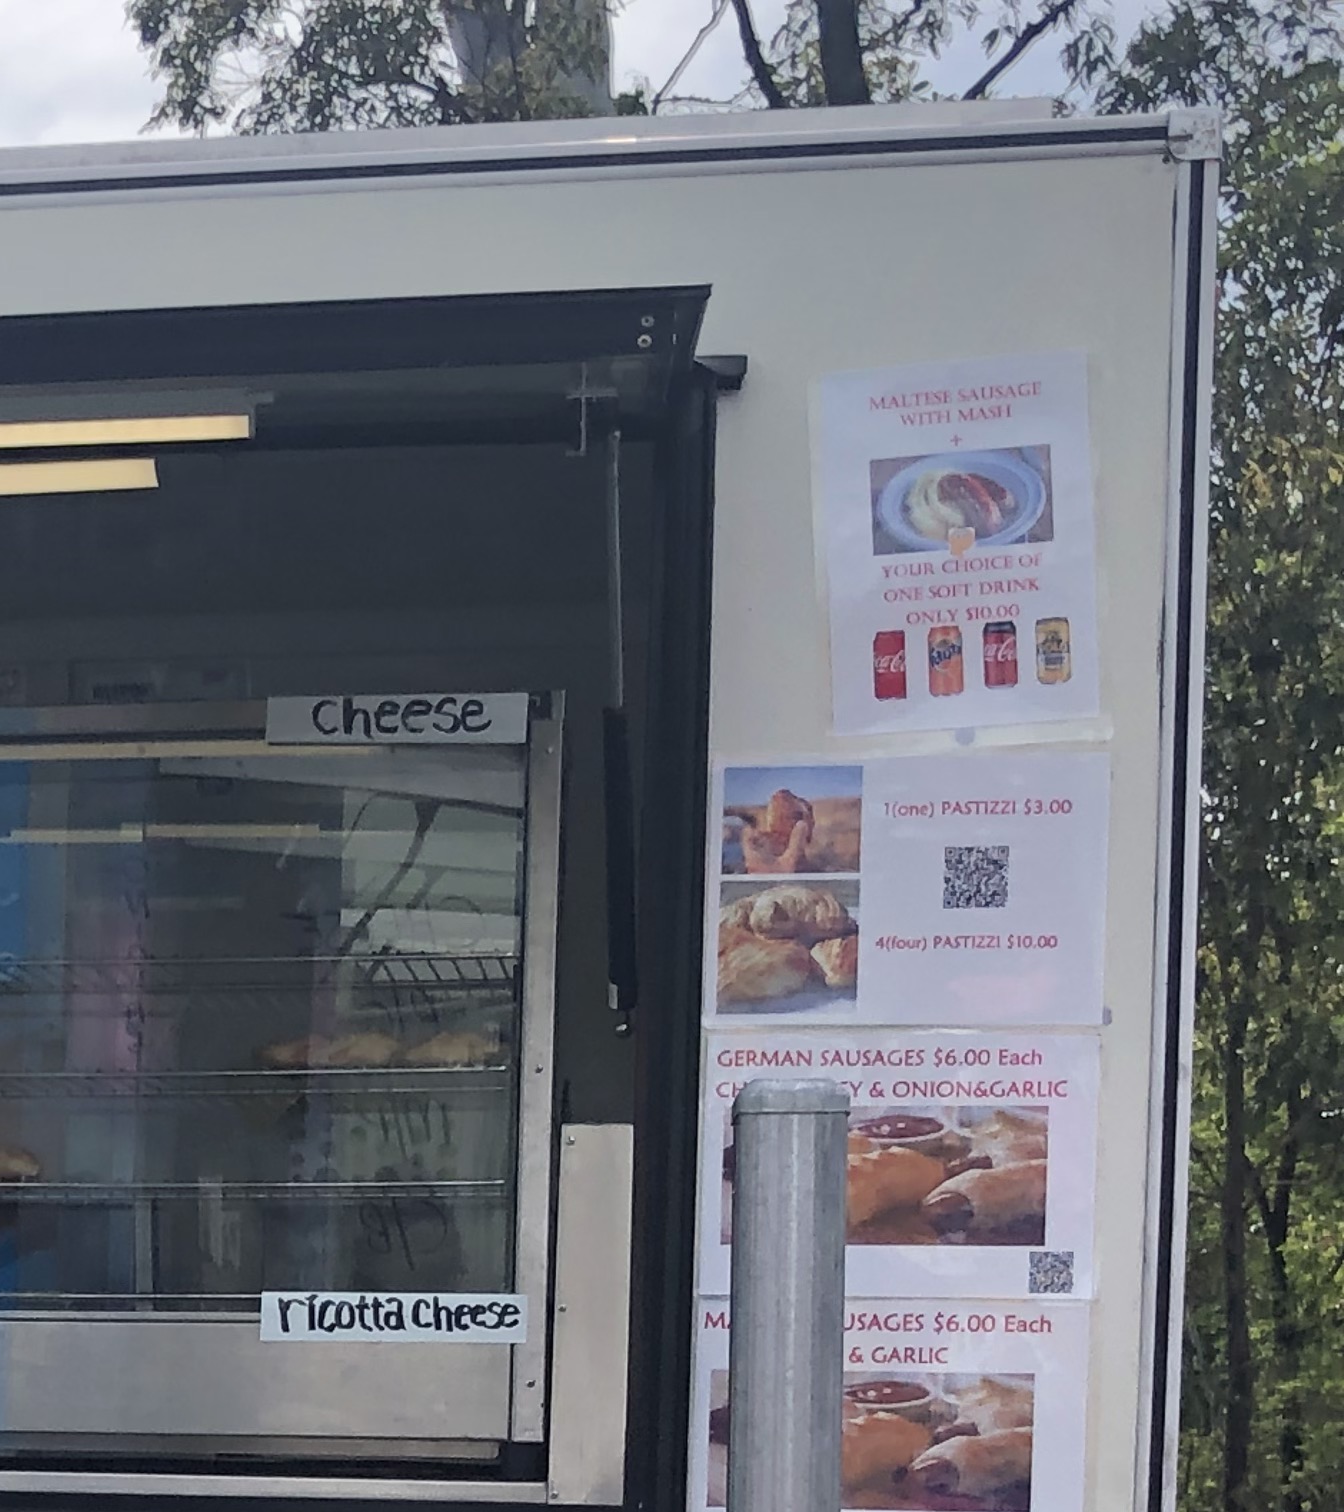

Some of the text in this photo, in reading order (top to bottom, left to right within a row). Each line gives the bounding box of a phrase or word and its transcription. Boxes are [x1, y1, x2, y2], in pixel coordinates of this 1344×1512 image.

[869, 382, 1041, 410] MALTESE SAUSAGE
[900, 405, 1012, 426] WITH MASH
[882, 553, 1043, 579] YOUR CHOICE OF
[883, 578, 1040, 603] ONE SOFT DRINK
[907, 604, 1021, 625] ONLY $10.00
[884, 799, 1073, 818] 1(one) PASTIZZI $3.00
[875, 934, 1059, 952] 4(four) PASTIZZI $10.00
[717, 1048, 1043, 1067] GERMAN SAUSAGES $6.00 Each
[869, 1081, 885, 1098] &
[891, 1080, 1068, 1100] ONION&GARLIC
[278, 1294, 407, 1333] ricotta
[933, 1312, 996, 1334] $6.00
[1004, 1314, 1053, 1333] Each
[848, 1346, 949, 1365] & GARLIC
